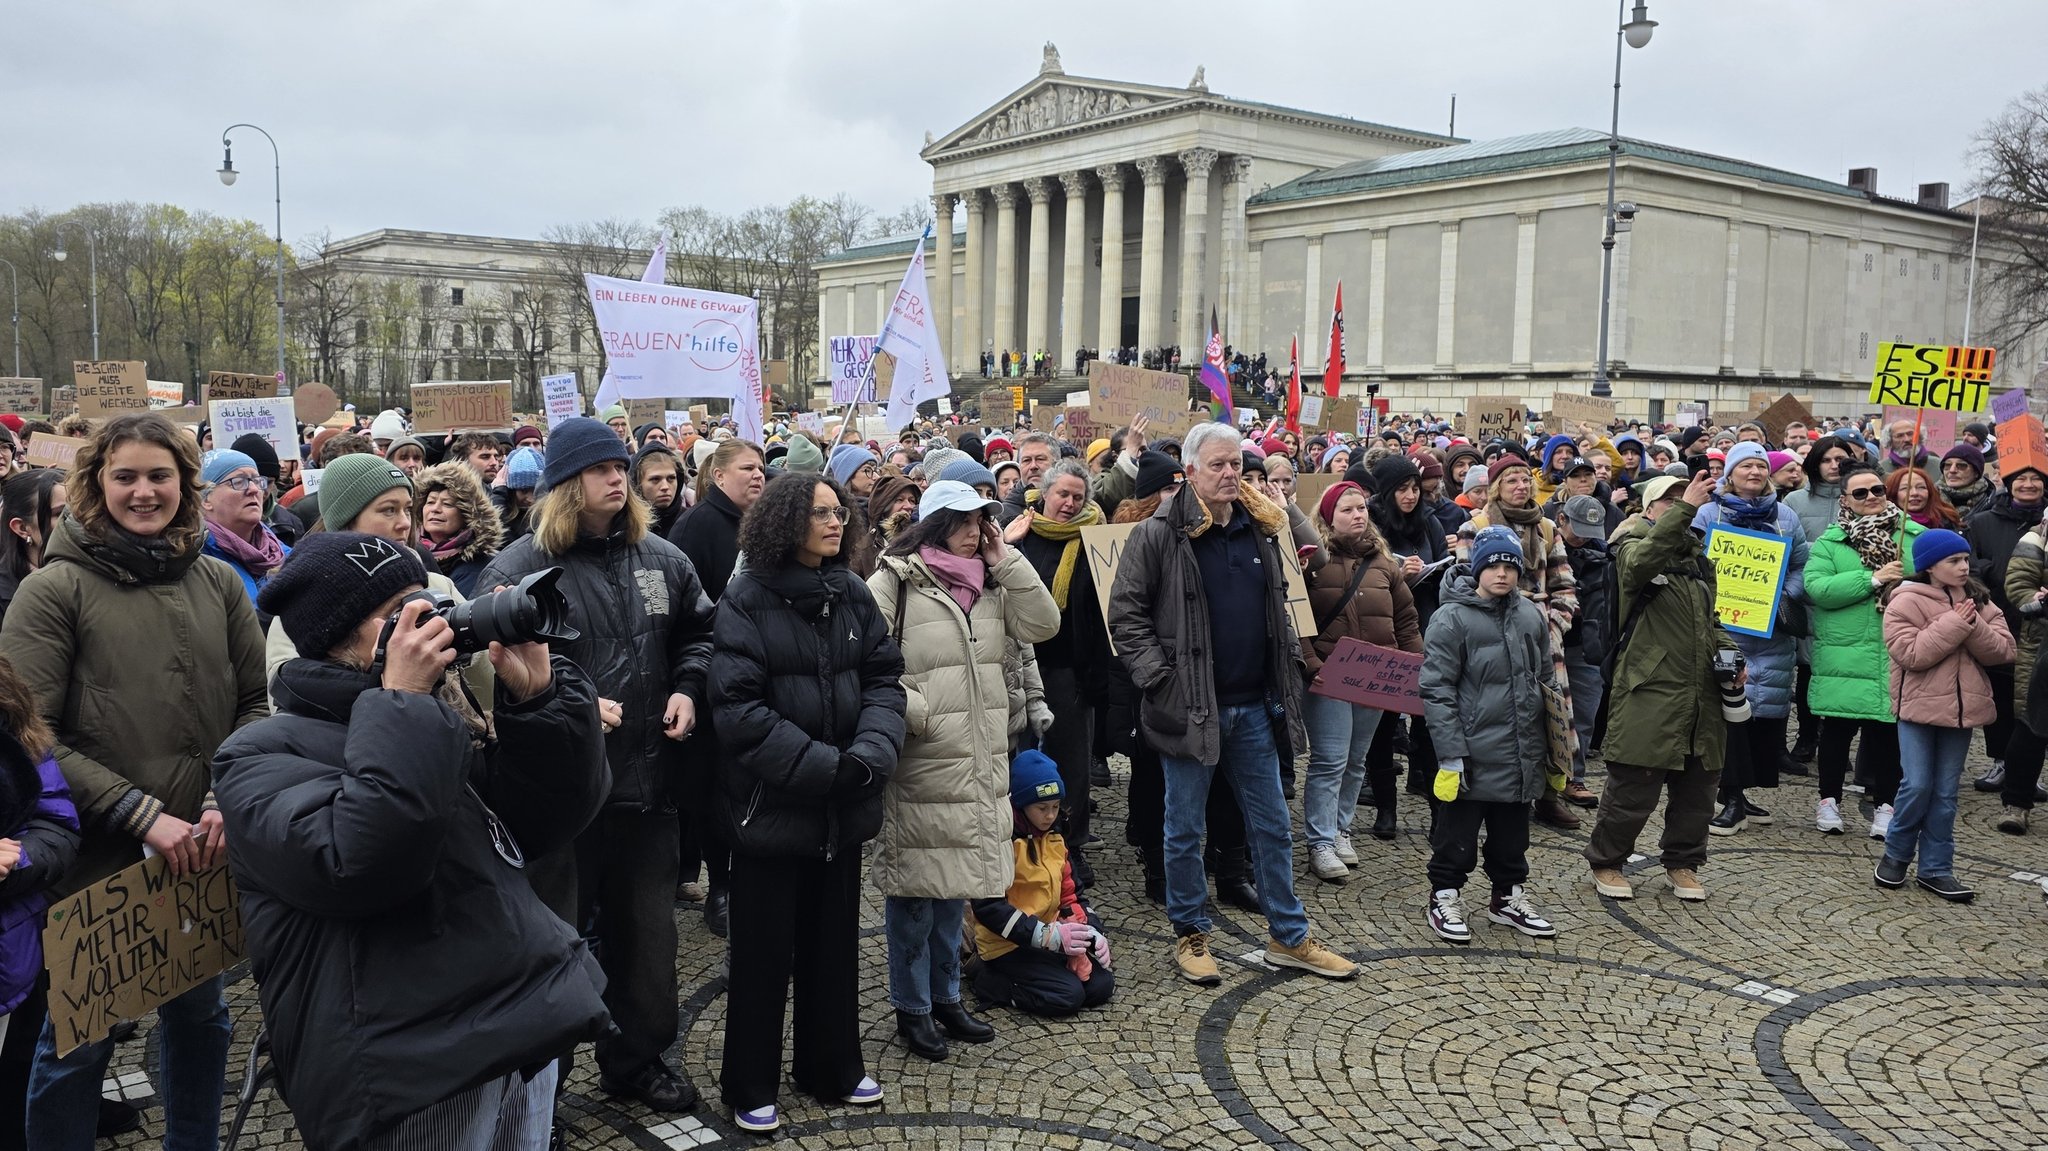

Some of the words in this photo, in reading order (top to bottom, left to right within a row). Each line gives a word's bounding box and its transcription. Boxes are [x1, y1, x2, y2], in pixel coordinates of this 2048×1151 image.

[595, 289, 614, 301] EIN
[618, 291, 657, 304] LEBEN
[661, 295, 697, 308] OHNE
[1882, 343, 1944, 376] ES
[91, 363, 127, 375] SCHAM
[98, 375, 121, 385] MUSS
[210, 374, 245, 389] KEIN
[1100, 366, 1144, 388] ANGRY
[1110, 386, 1139, 401] WILL
[1876, 371, 1990, 413] REICHT
[100, 397, 149, 409] WECHSELN
[415, 397, 438, 408] weil
[1108, 401, 1132, 416] THE
[221, 407, 236, 417] du
[237, 406, 255, 417] bist
[258, 405, 272, 417] die
[415, 408, 436, 419] wir
[1480, 412, 1504, 424] NUR
[224, 416, 276, 432] STIMME
[1071, 426, 1101, 439] JUST
[1713, 535, 1777, 564] STRONGER
[60, 873, 130, 940] ALS
[141, 861, 190, 895] WI
[70, 903, 155, 980] MEHR
[62, 929, 168, 1011] WOLLTEN
[68, 990, 119, 1044] WIR
[140, 943, 206, 1006] KEINE
